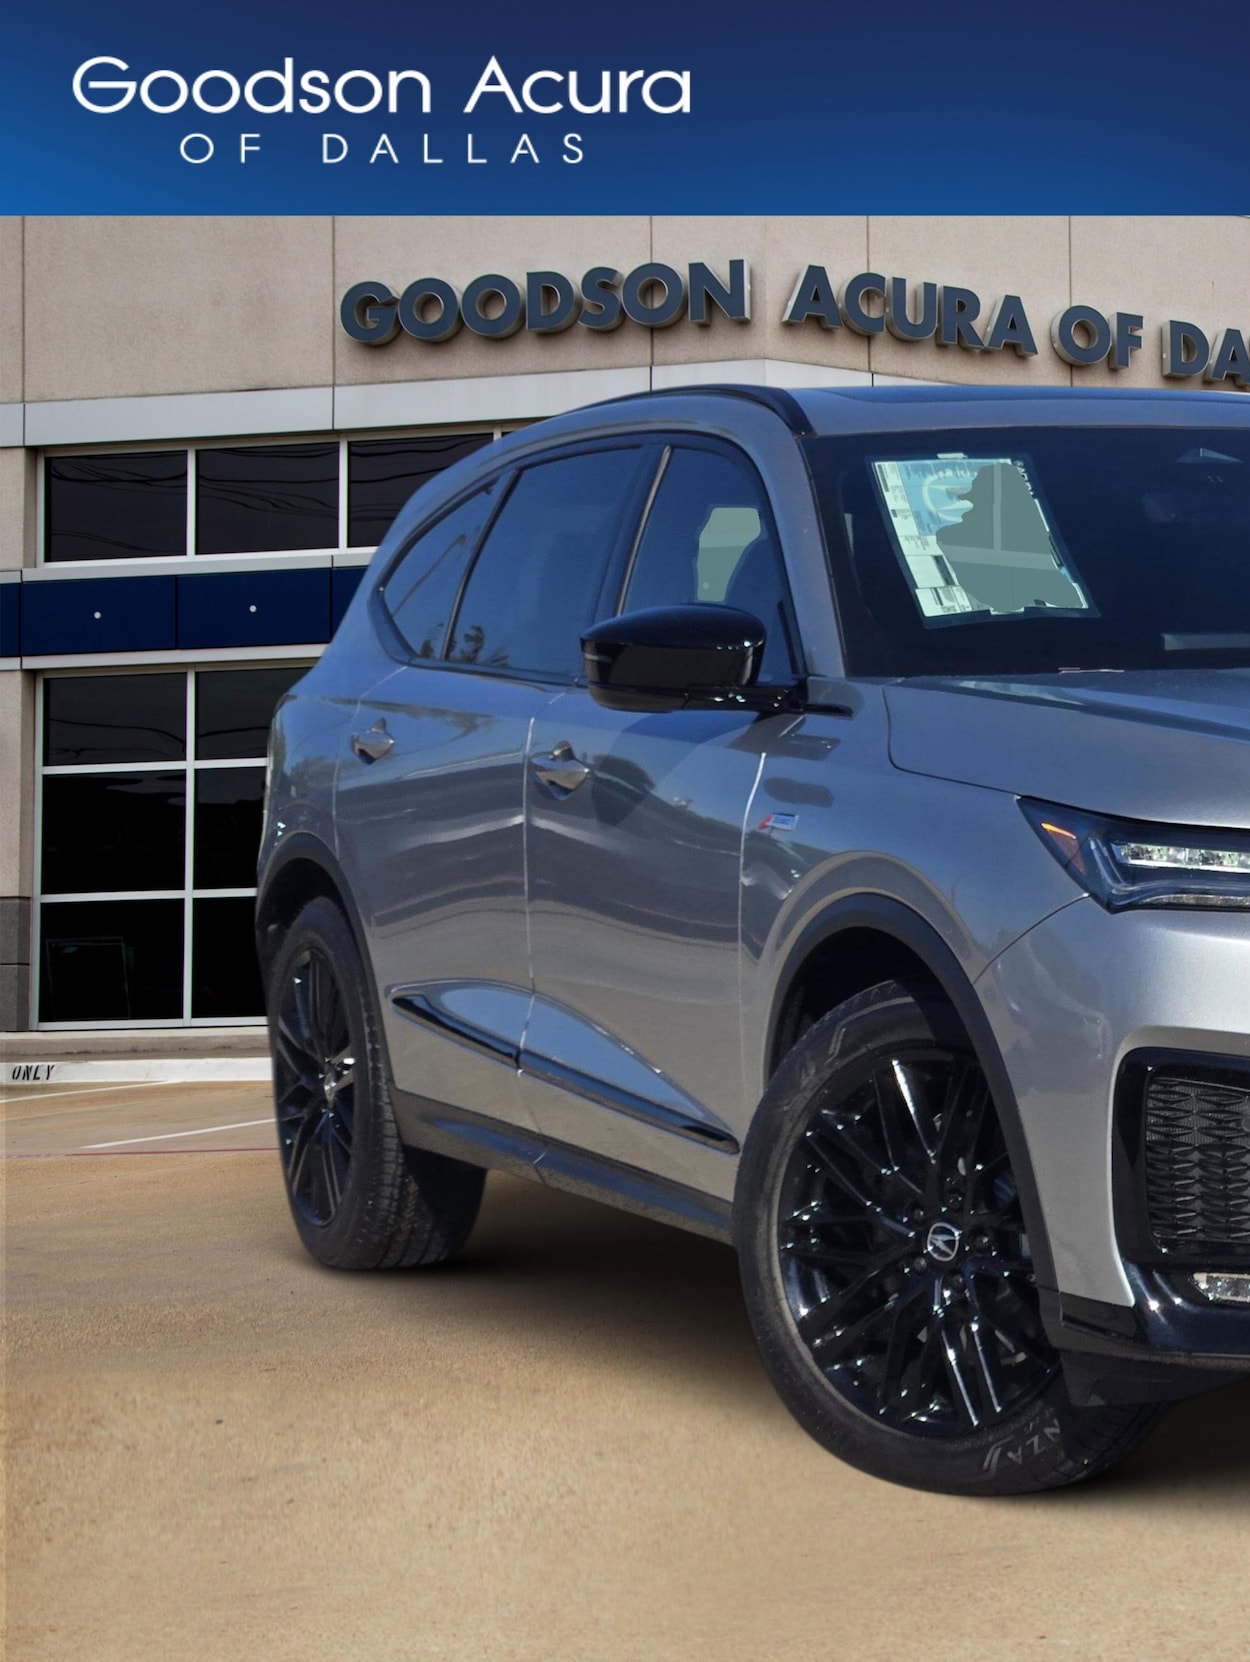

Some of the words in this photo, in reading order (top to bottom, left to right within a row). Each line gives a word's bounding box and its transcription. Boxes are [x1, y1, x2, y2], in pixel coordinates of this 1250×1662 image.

[340, 259, 750, 346] GOODSON
[782, 264, 1038, 357] ACURA
[1051, 305, 1143, 370] OF
[12, 1064, 55, 1080] ONLY
